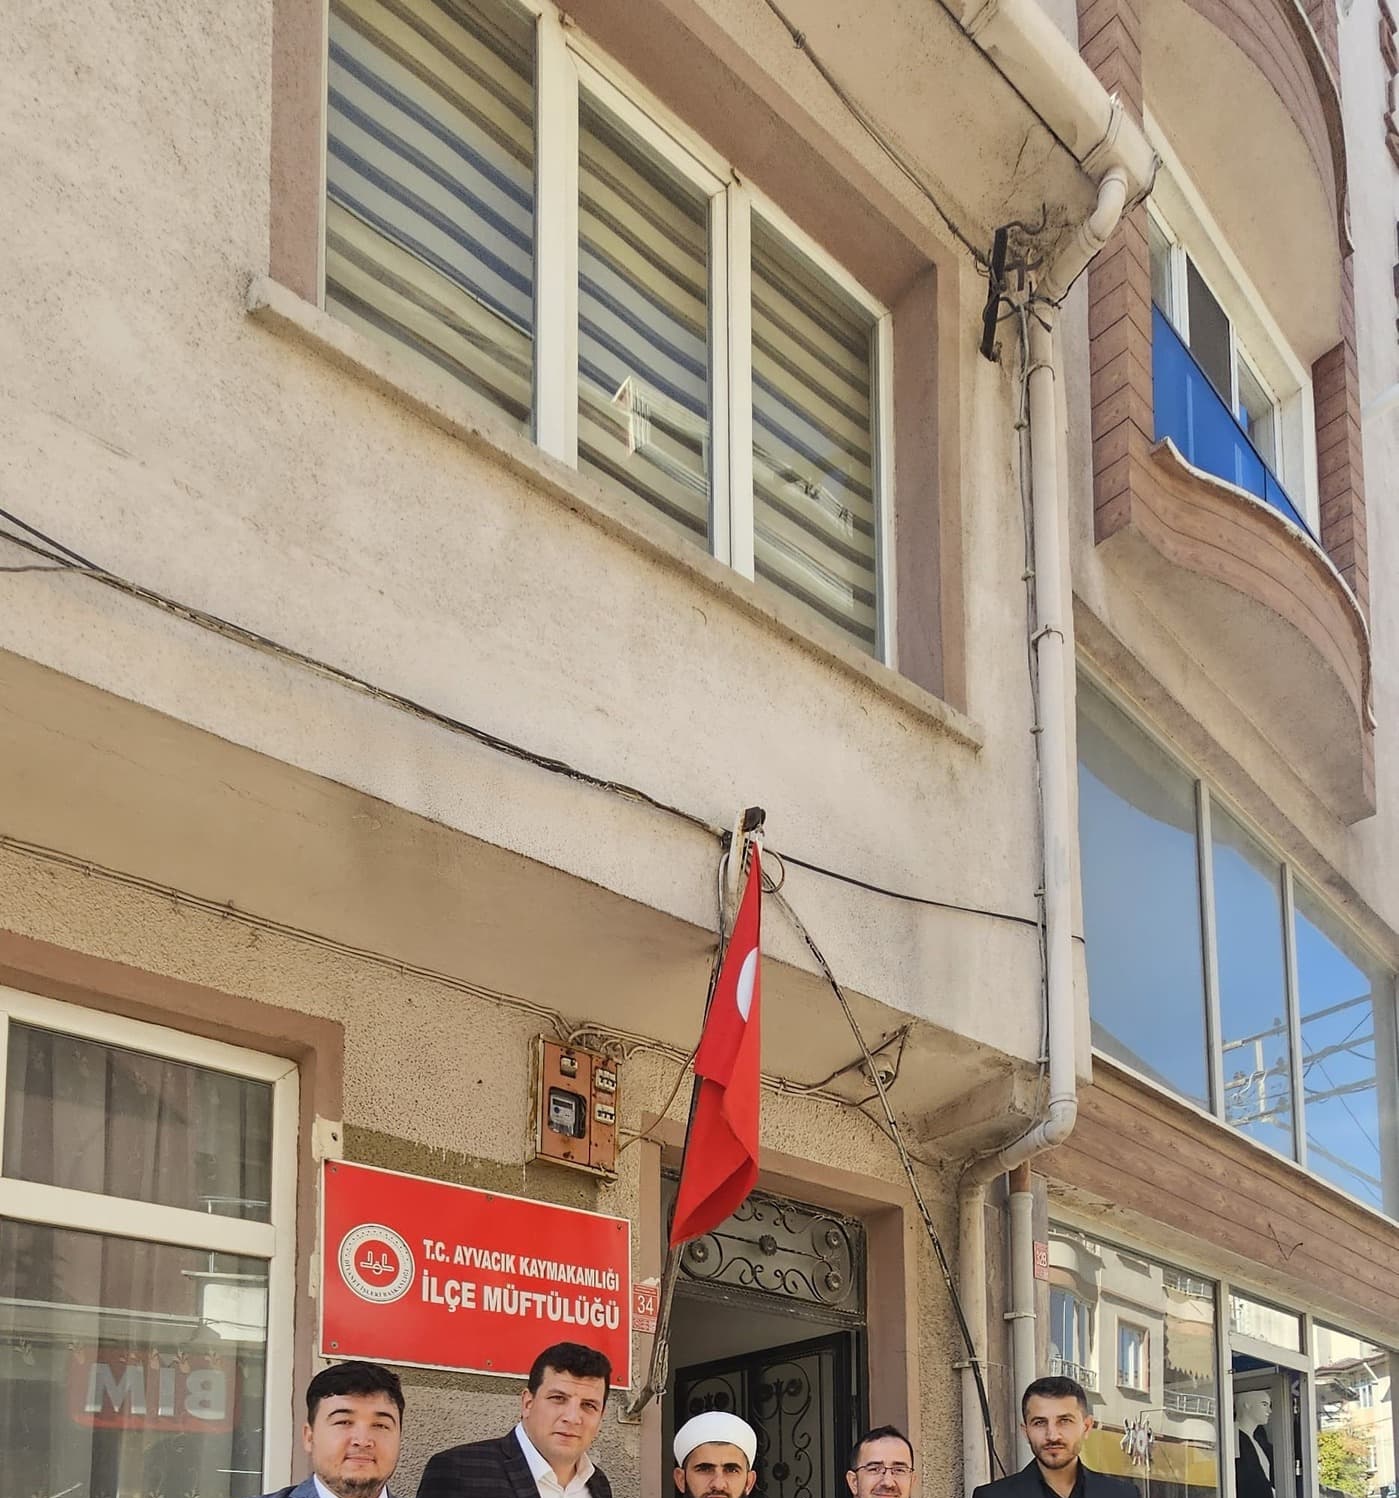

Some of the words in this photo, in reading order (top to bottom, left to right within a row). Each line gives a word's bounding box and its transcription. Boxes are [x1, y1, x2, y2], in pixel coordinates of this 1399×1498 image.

[423, 1238, 450, 1263] T.C.
[453, 1244, 516, 1274] AYVACIK
[519, 1256, 620, 1291] KAYMAKAMLIĞI
[421, 1269, 476, 1313] İLÇE
[483, 1284, 620, 1330] MÜFTÜLÜĞÜ
[637, 1295, 654, 1315] 34
